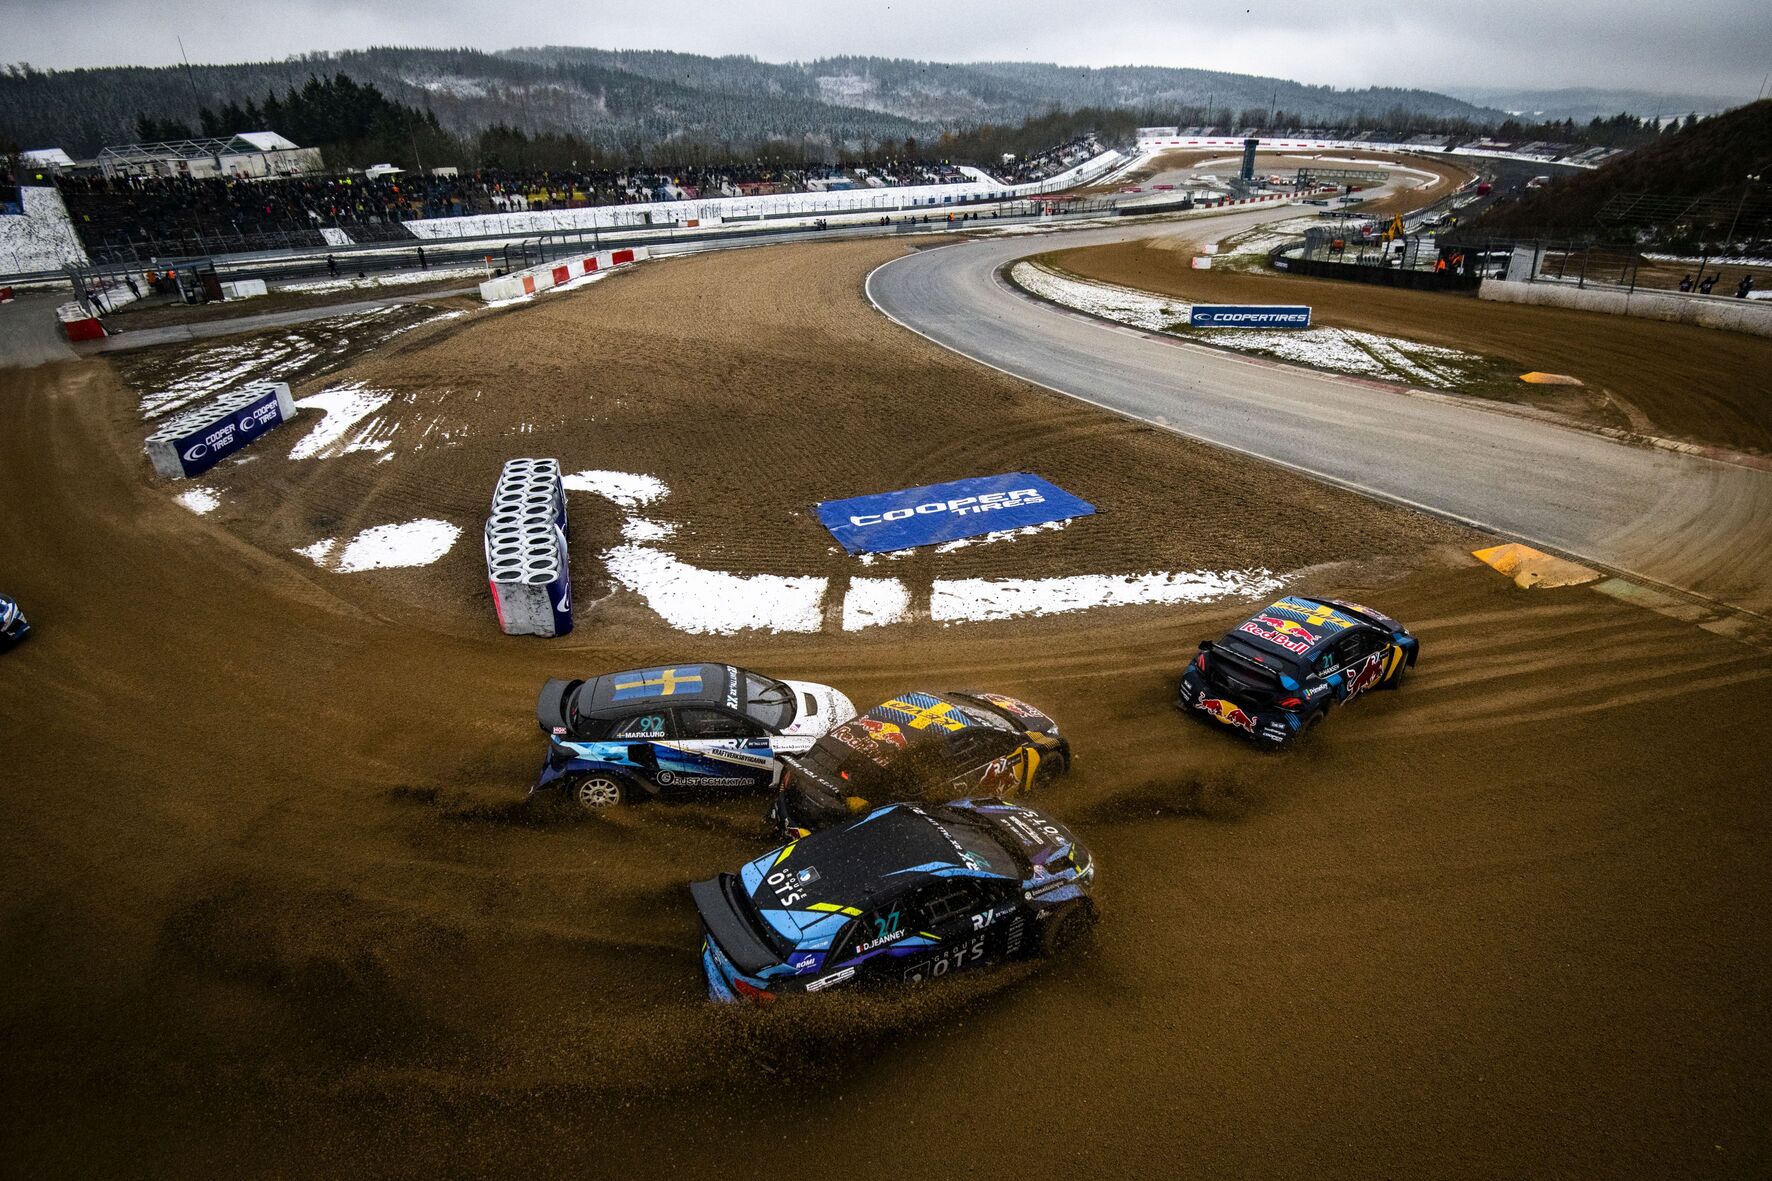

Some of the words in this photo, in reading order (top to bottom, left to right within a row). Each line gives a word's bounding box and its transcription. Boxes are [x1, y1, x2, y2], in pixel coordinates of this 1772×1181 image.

[253, 399, 278, 419] COOPER
[258, 408, 277, 425] TIRES
[205, 423, 236, 445] COOPER
[211, 434, 234, 452] TIRES
[850, 488, 1040, 526] COOPER
[950, 496, 1046, 516] TIRES
[1239, 622, 1277, 639] Red
[1270, 634, 1310, 655] Bull
[1322, 654, 1334, 669] 21
[1309, 682, 1329, 696] PrimeKey
[640, 715, 664, 731] 92
[625, 731, 666, 739] MARKLUND
[701, 777, 740, 786] SCHAKT
[767, 872, 801, 907] OTS
[782, 868, 807, 899] GROUPE
[875, 911, 900, 938] 27
[971, 908, 996, 931] RX
[863, 928, 906, 950] D.JEANNEY
[934, 934, 985, 962] GROUPE
[796, 957, 816, 969] ROMI
[933, 941, 984, 977] OTS
